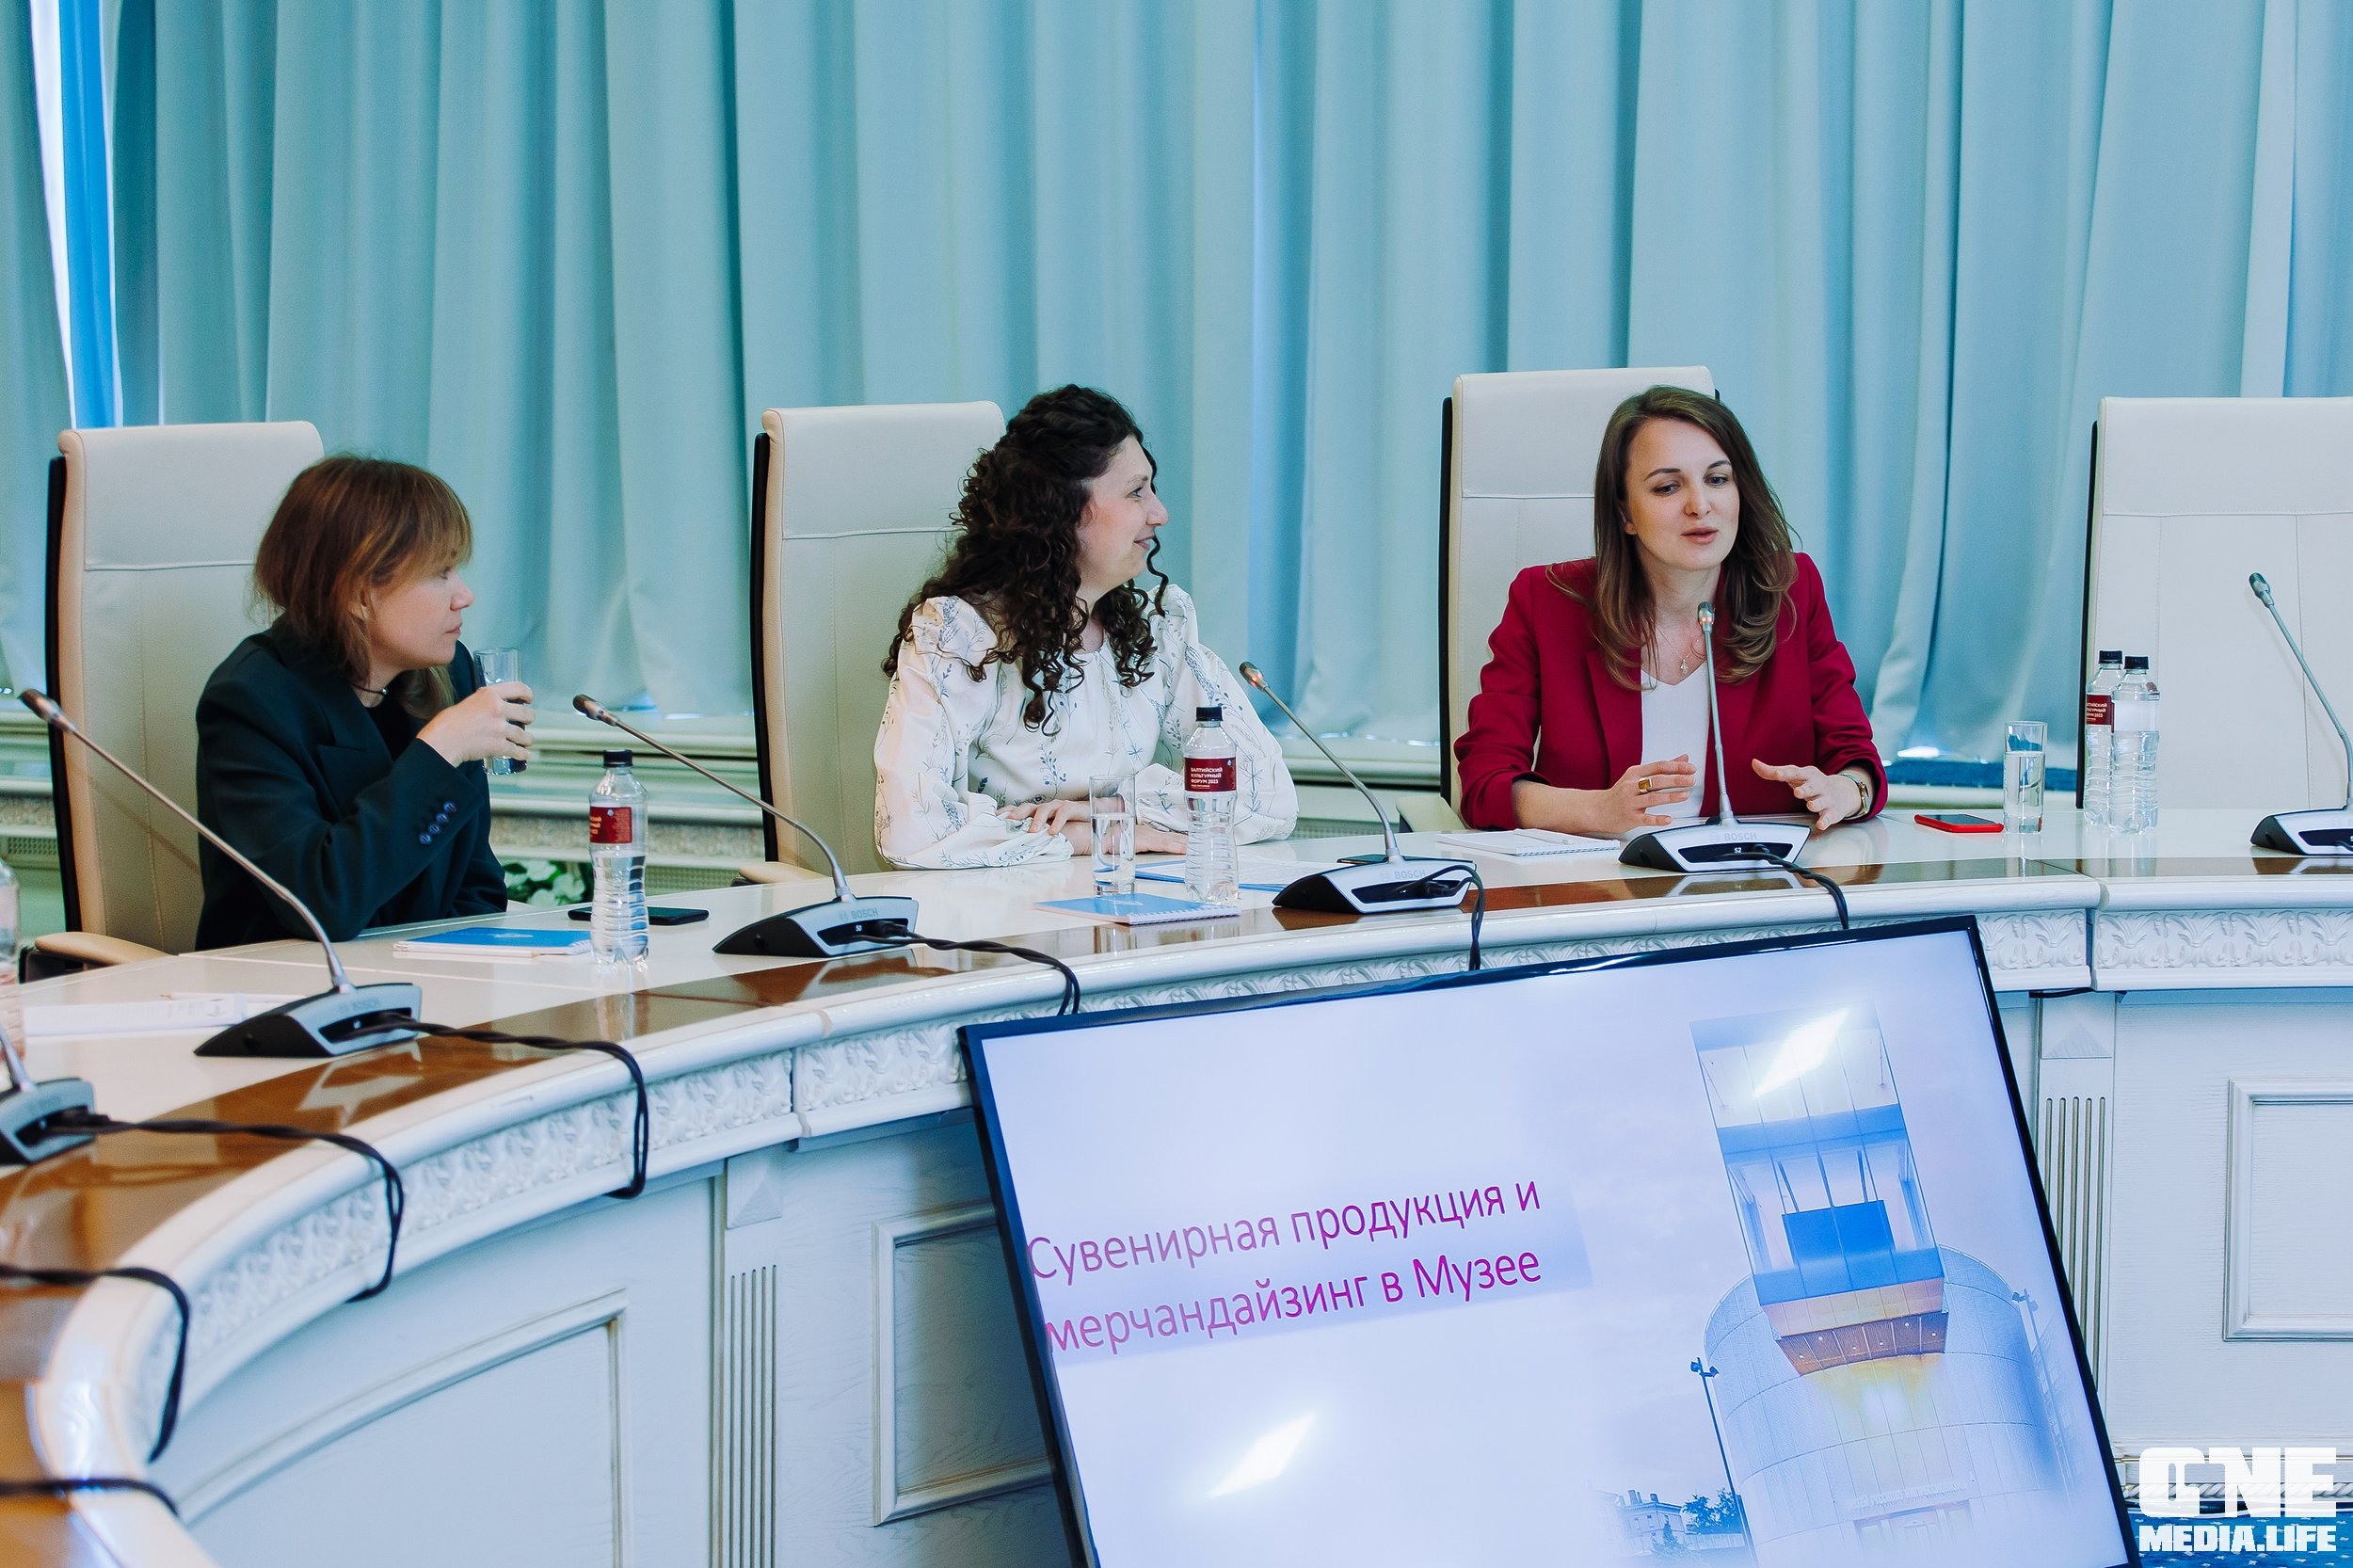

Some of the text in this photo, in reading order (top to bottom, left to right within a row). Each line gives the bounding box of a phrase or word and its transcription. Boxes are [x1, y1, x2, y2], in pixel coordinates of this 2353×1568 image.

[1724, 832, 1757, 840] BOSCH
[1395, 870, 1426, 880] BOSCH
[852, 908, 878, 920] BOSCH
[1028, 1181, 1540, 1286] Сувенирная продукция и
[1046, 1252, 1541, 1354] мерчандайзинг в Музее
